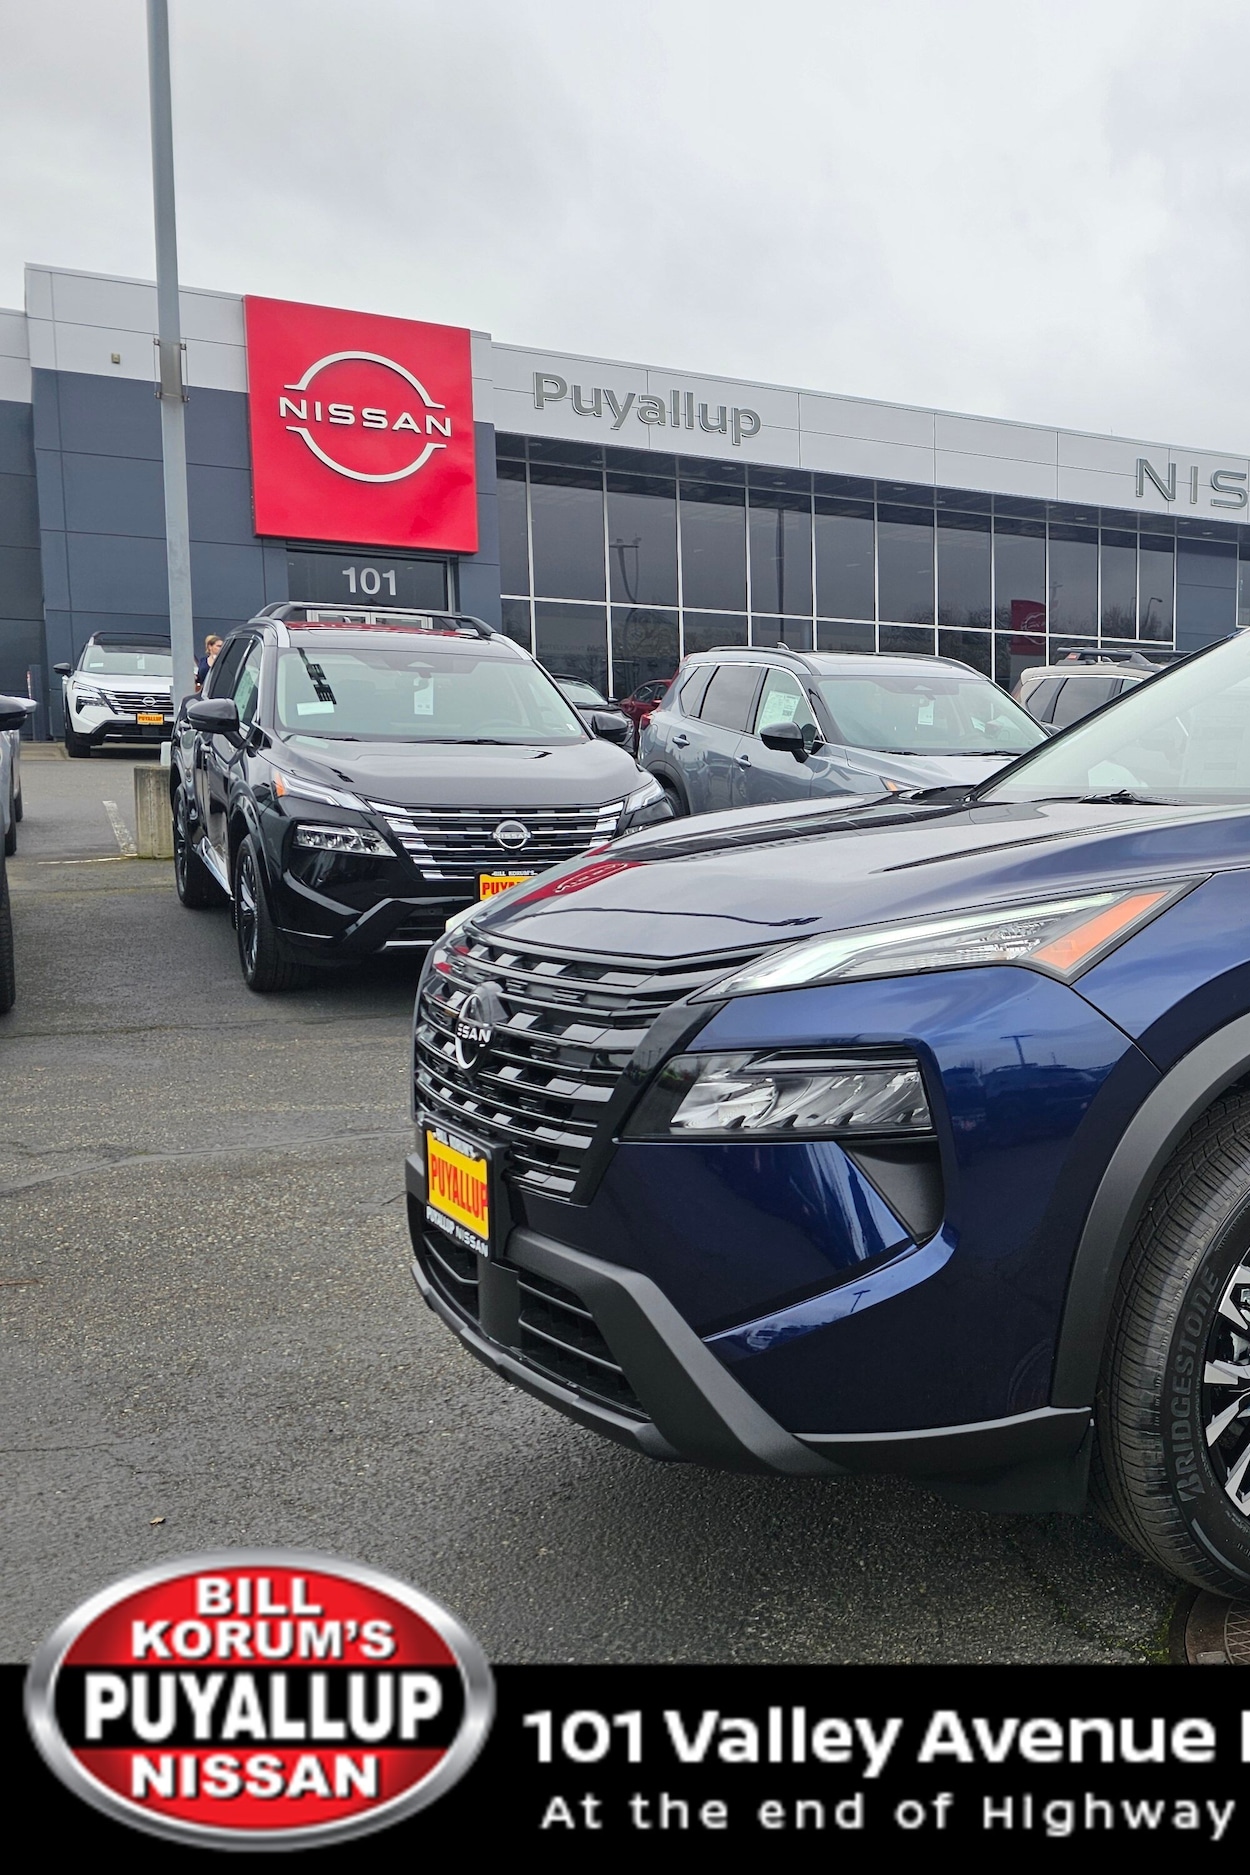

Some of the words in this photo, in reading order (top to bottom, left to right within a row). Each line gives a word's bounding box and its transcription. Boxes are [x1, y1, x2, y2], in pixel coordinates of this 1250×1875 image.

[279, 396, 451, 437] NISSAN
[533, 371, 762, 446] Puyallup
[342, 567, 396, 596] 101
[493, 831, 531, 839] NISSAN
[430, 1153, 489, 1222] PUYALLUP
[455, 1225, 489, 1258] NISSAN
[1172, 1264, 1220, 1502] BRIDGESTONE
